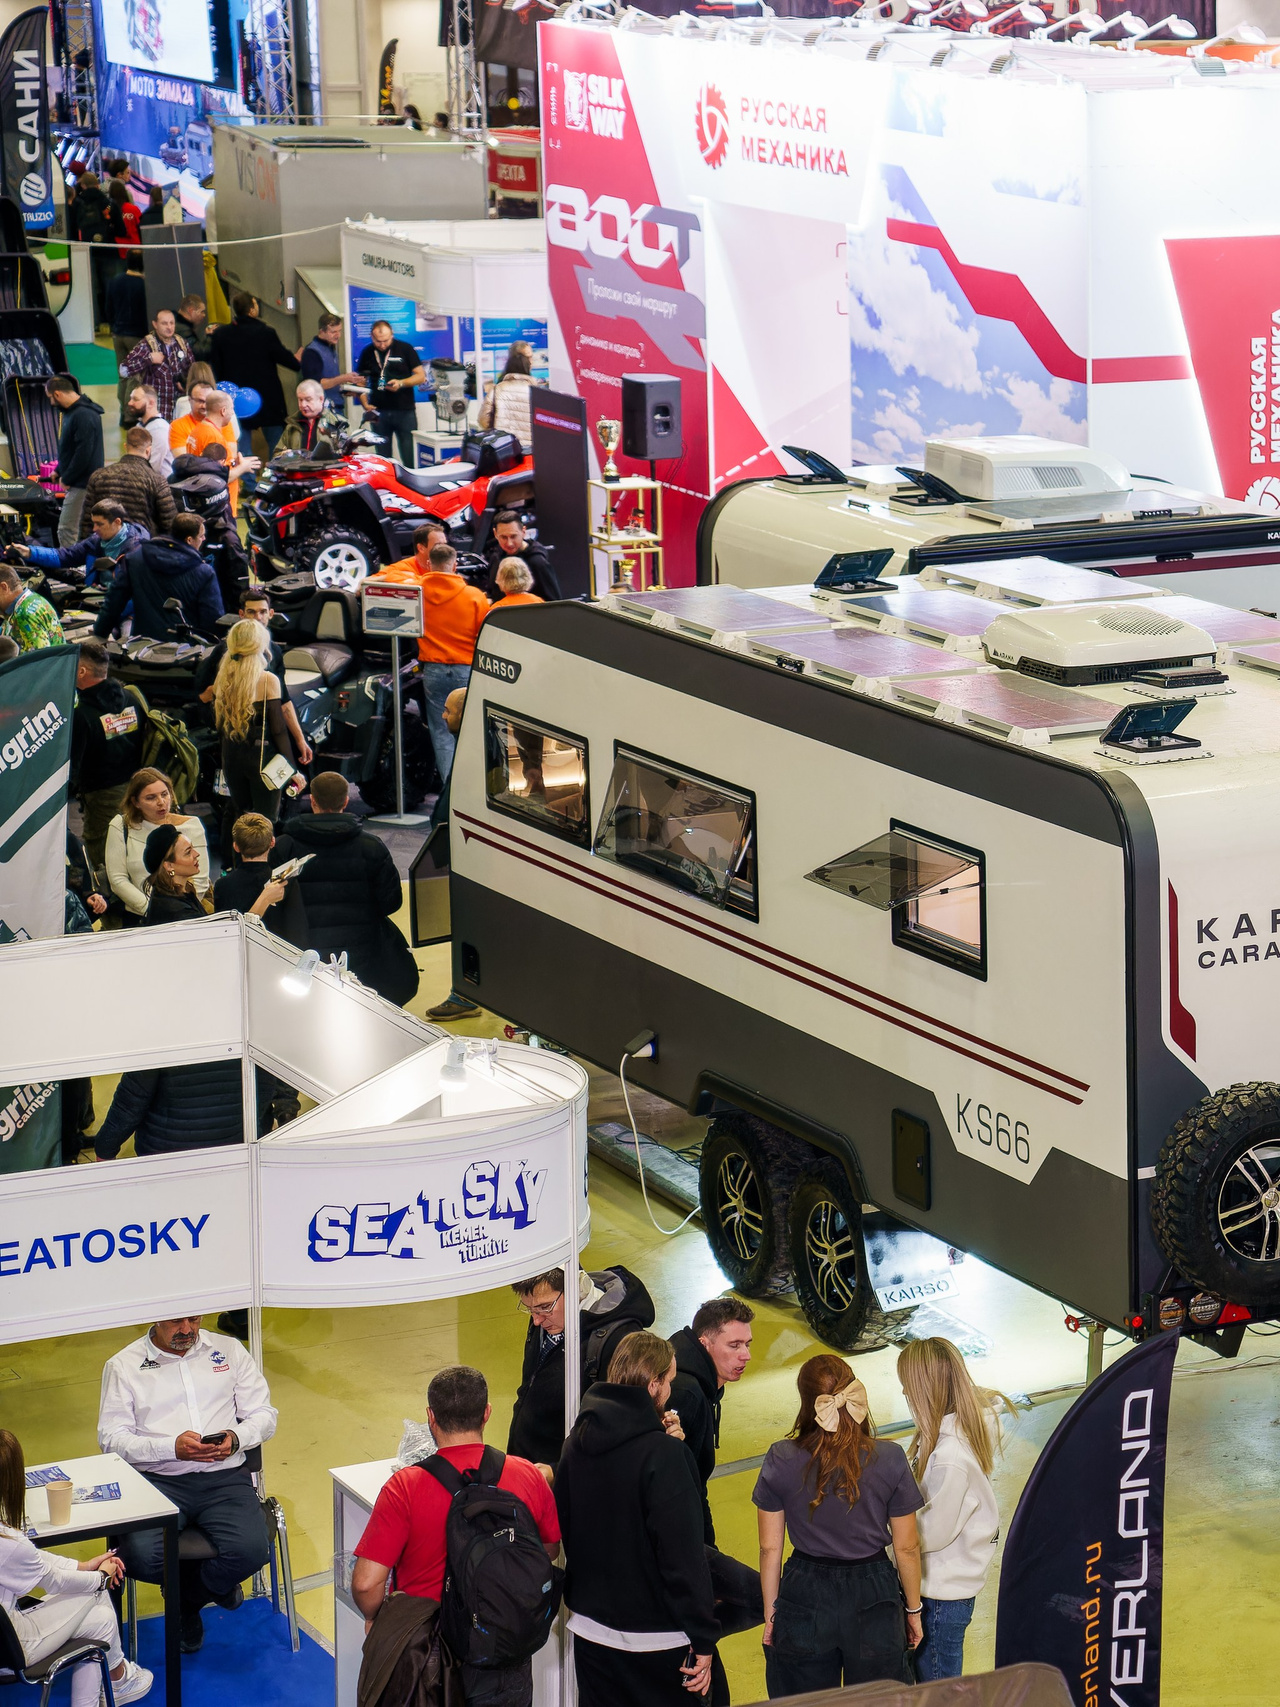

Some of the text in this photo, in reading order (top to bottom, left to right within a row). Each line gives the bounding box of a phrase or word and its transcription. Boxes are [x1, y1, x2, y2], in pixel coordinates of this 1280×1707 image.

[13, 50, 40, 163] САНИ
[587, 73, 627, 109] SILK
[588, 105, 626, 140] WAY
[741, 97, 827, 133] РУССКАЯ
[741, 135, 849, 177] МЕХАНИКА
[1250, 337, 1266, 464] РУССКАЯ
[478, 653, 515, 680] KARSO
[23, 715, 62, 759] camper
[956, 1092, 1031, 1164] KS66
[440, 1225, 488, 1249] KEMER
[883, 1278, 951, 1308] KARSO
